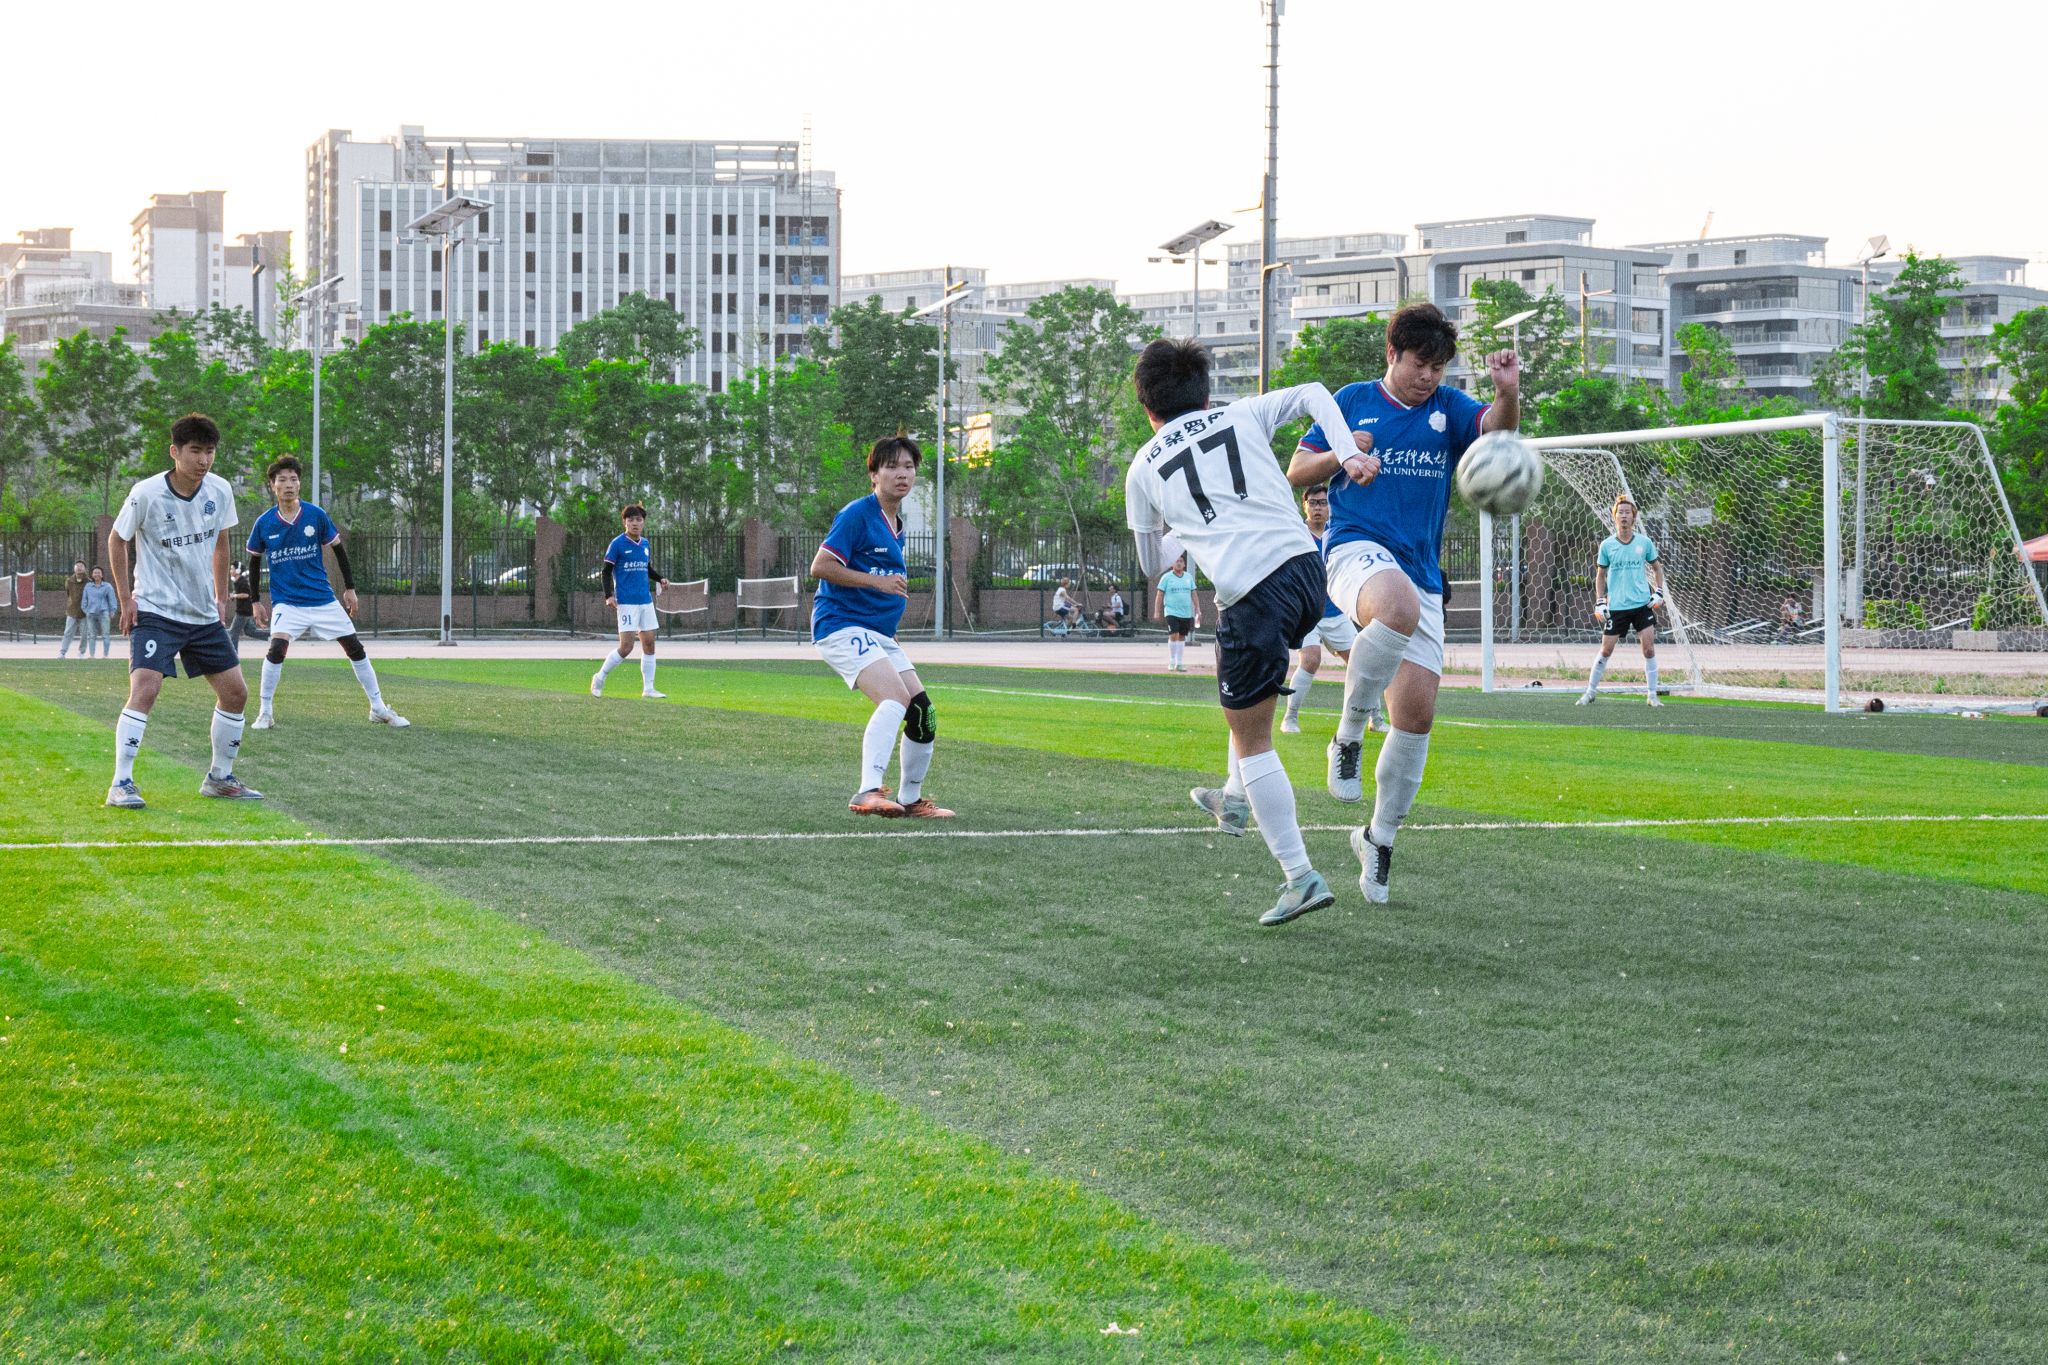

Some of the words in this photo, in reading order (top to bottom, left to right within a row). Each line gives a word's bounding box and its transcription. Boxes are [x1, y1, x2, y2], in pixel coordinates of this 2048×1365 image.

[1157, 425, 1249, 525] 77
[1394, 467, 1445, 479] UNIVERSITY
[274, 612, 282, 626] 7
[621, 614, 632, 626] 91
[144, 639, 158, 659] 9
[850, 632, 879, 656] 24
